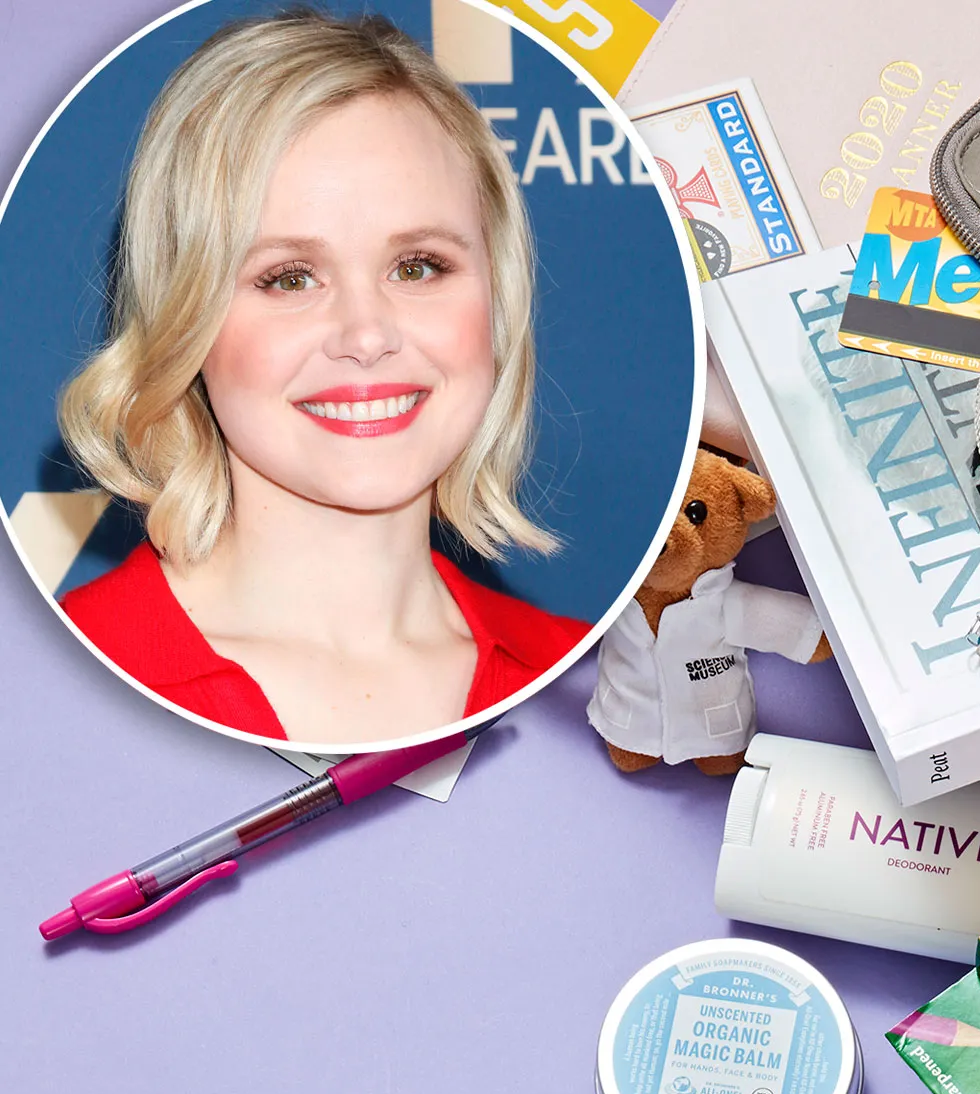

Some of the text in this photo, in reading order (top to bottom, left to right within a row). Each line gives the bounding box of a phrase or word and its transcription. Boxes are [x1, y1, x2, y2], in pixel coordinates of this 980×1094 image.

[820, 60, 923, 210] 2020
[891, 79, 963, 186] ANNER
[716, 101, 793, 254] STANDARD
[886, 200, 938, 229] MTA
[930, 351, 965, 367] Insert
[688, 654, 736, 681] MUSEUM
[931, 751, 950, 784] Peat
[817, 795, 836, 850] PARABEN FREE
[887, 857, 952, 876] DEODORANT
[685, 960, 712, 974] FAMILY
[713, 958, 762, 970] SOAPMAKERS
[703, 984, 779, 1004] BRONNER'S
[732, 977, 755, 988] DR.
[700, 1004, 772, 1026] UNSCENTED
[693, 1020, 772, 1046] ORGANIC
[673, 1039, 783, 1070] MAGIC BALM
[671, 1060, 688, 1069] FOR
[724, 1068, 745, 1078] FACE
[755, 1073, 778, 1082] BODY
